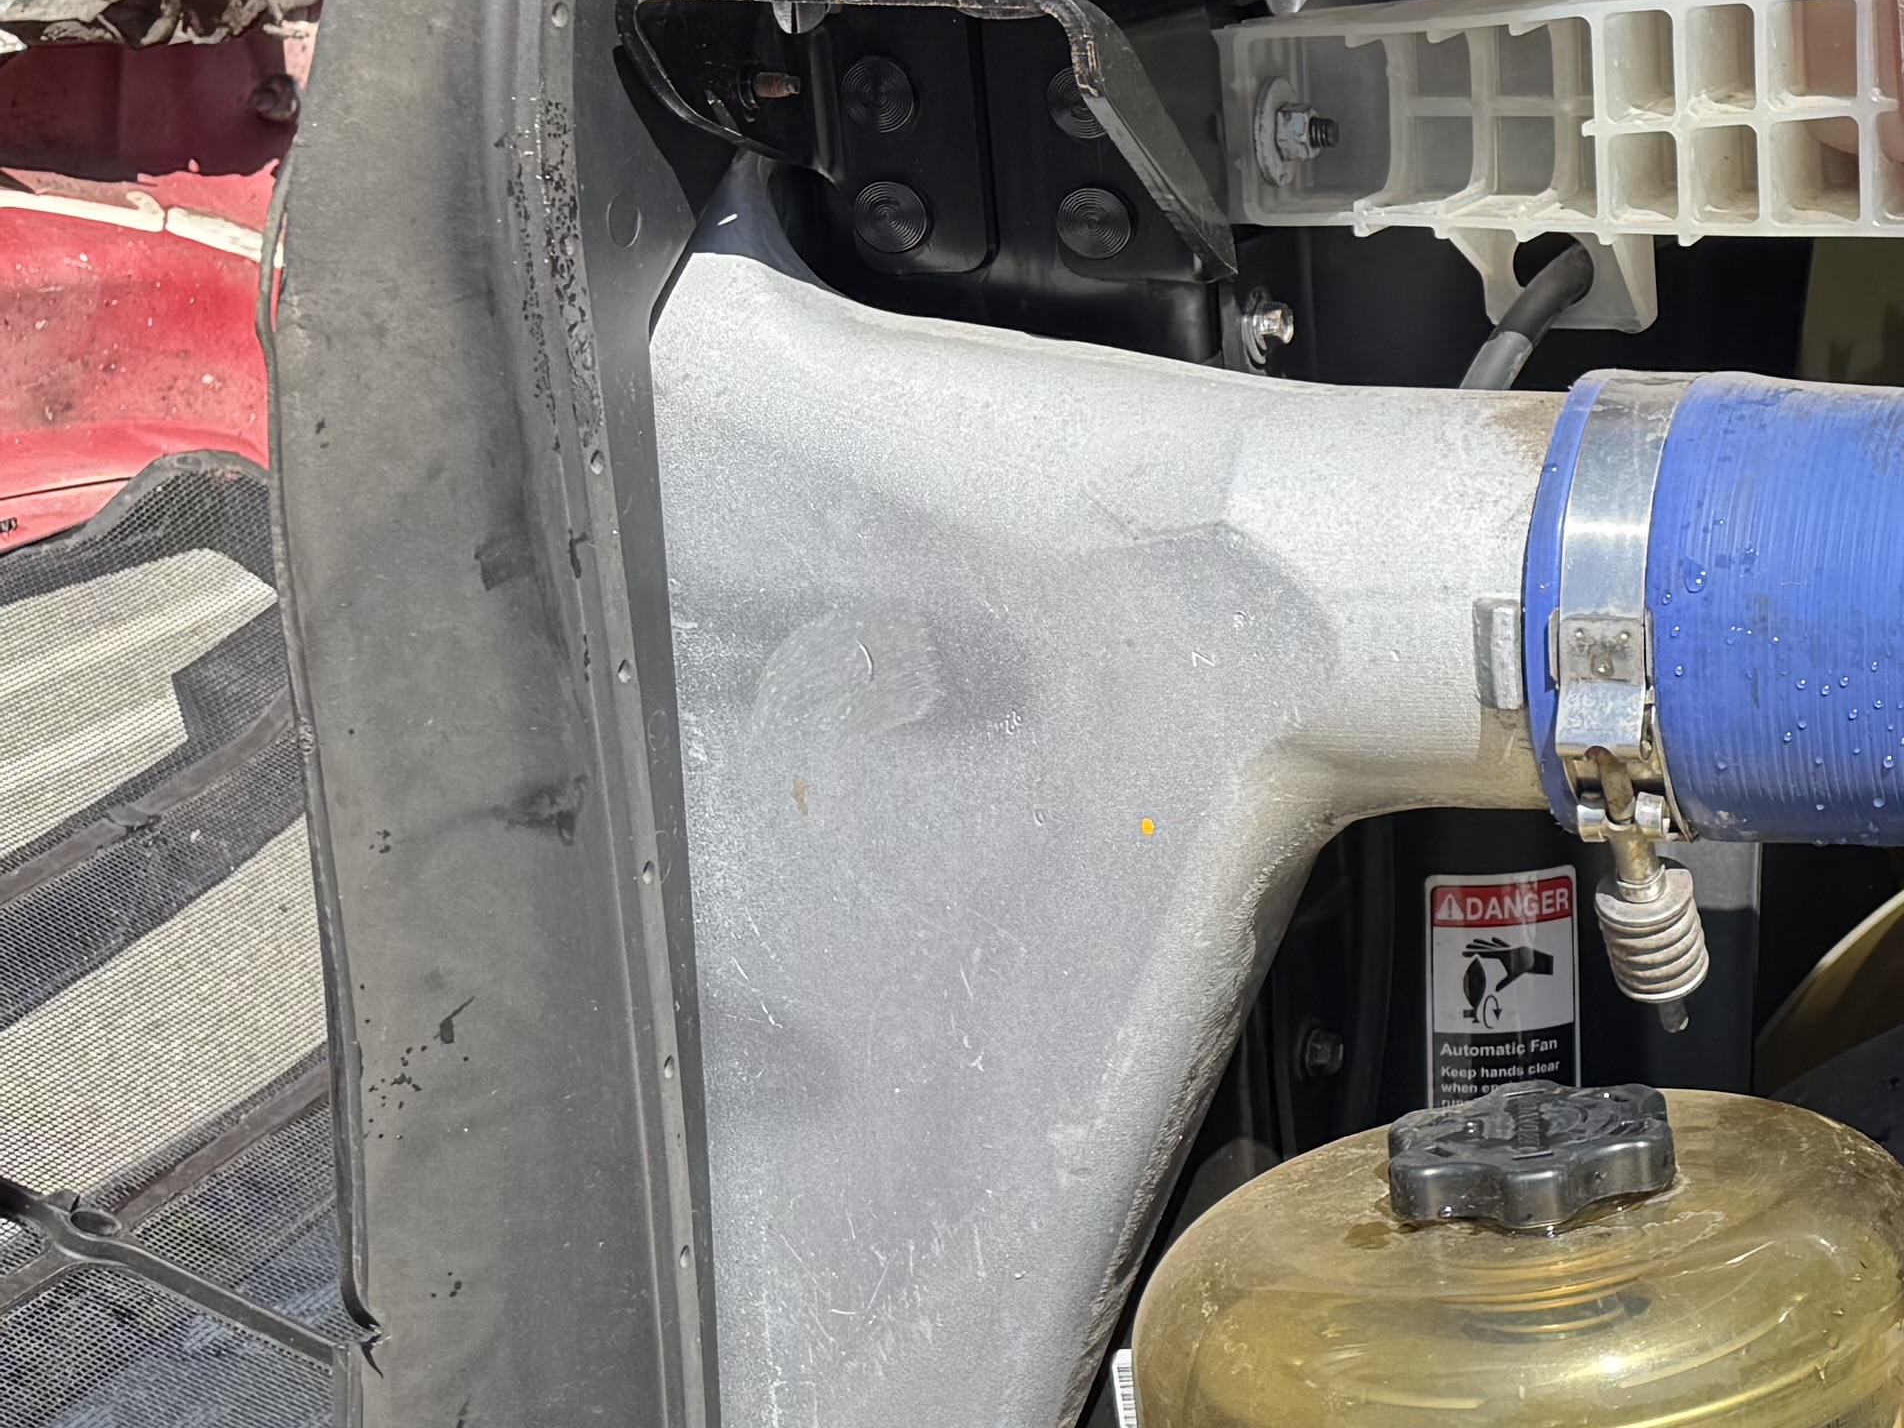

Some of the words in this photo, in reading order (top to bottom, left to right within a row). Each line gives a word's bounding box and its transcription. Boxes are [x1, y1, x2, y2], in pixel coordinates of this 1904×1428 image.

[1466, 887, 1569, 921] DANGER
[1440, 1042, 1525, 1057] Automatic
[1530, 1039, 1558, 1053] Fan
[1441, 1066, 1476, 1080] Keep
[1481, 1064, 1524, 1079] hands
[1528, 1060, 1560, 1075] clear
[1441, 1082, 1477, 1094] when
